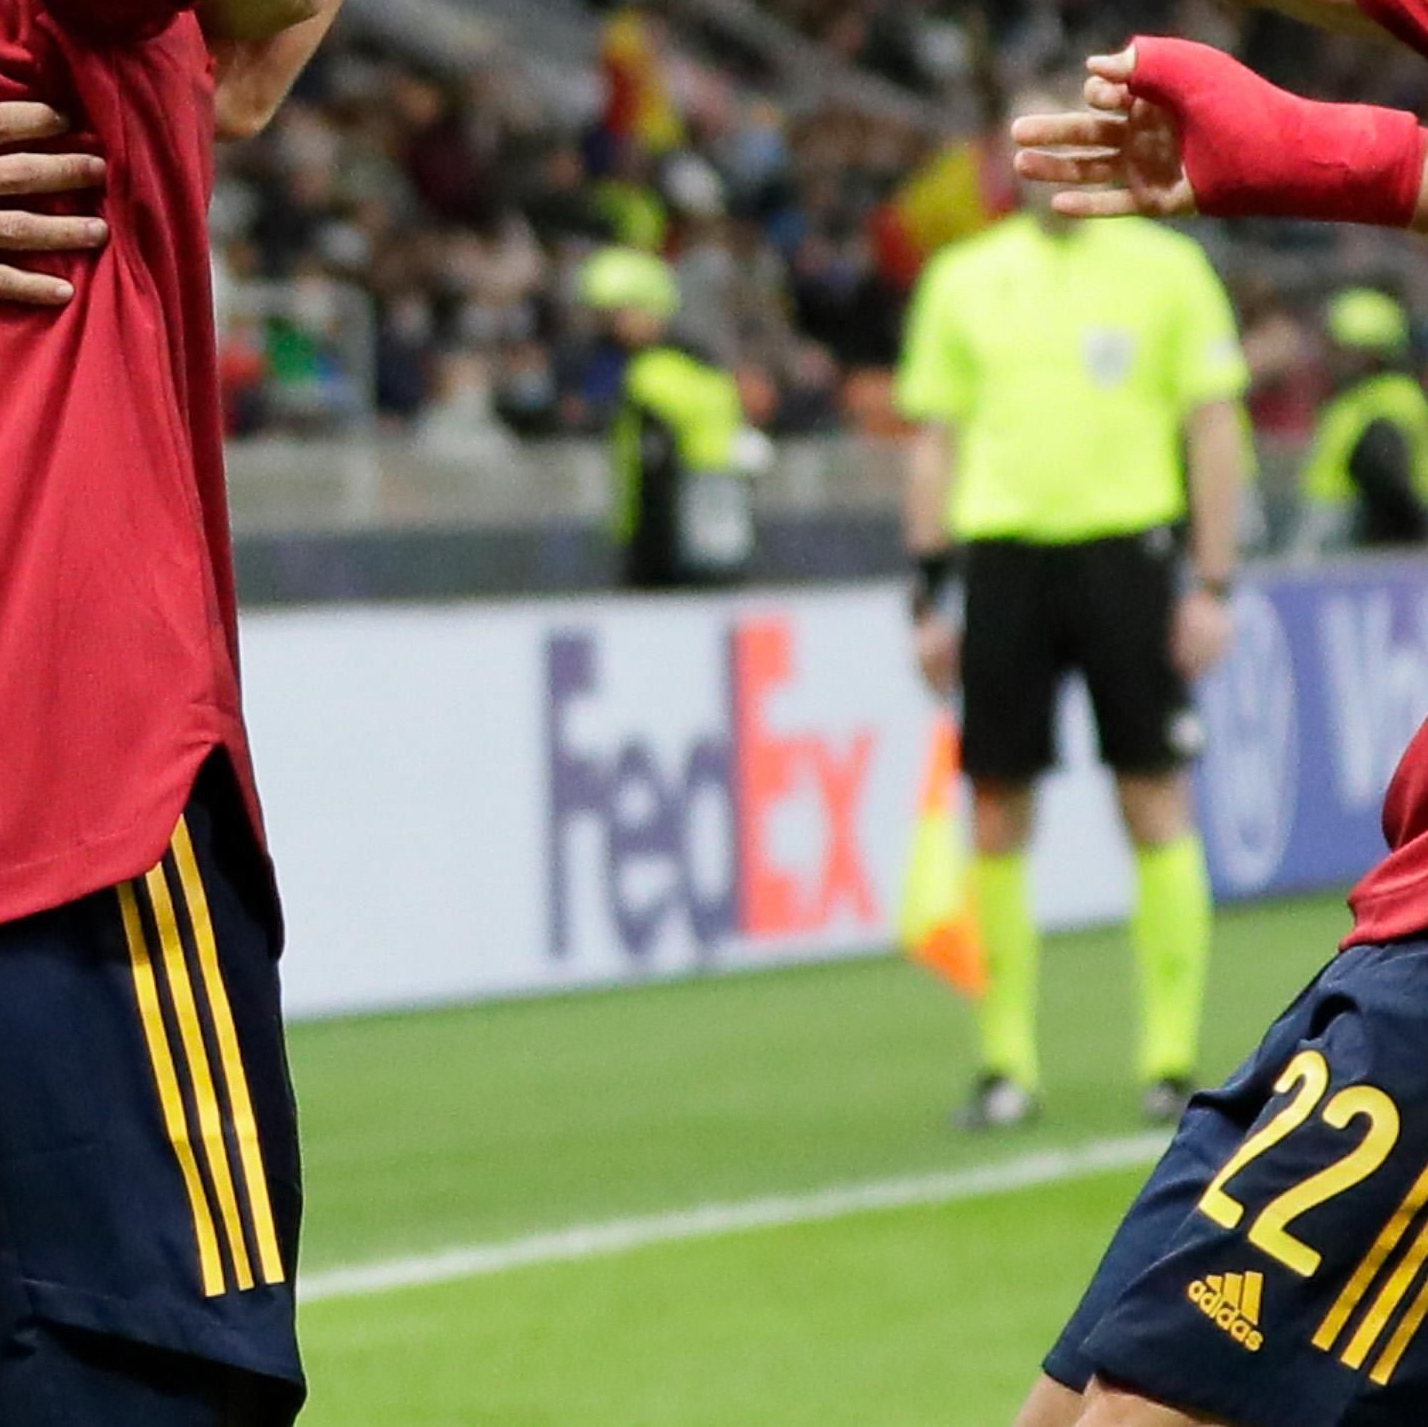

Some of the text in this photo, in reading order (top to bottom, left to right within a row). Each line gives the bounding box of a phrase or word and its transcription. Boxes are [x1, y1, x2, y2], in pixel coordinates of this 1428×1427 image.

[543, 612, 881, 964] FedEx
[1197, 1049, 1401, 1278] 22
[1186, 1278, 1264, 1353] adidas
